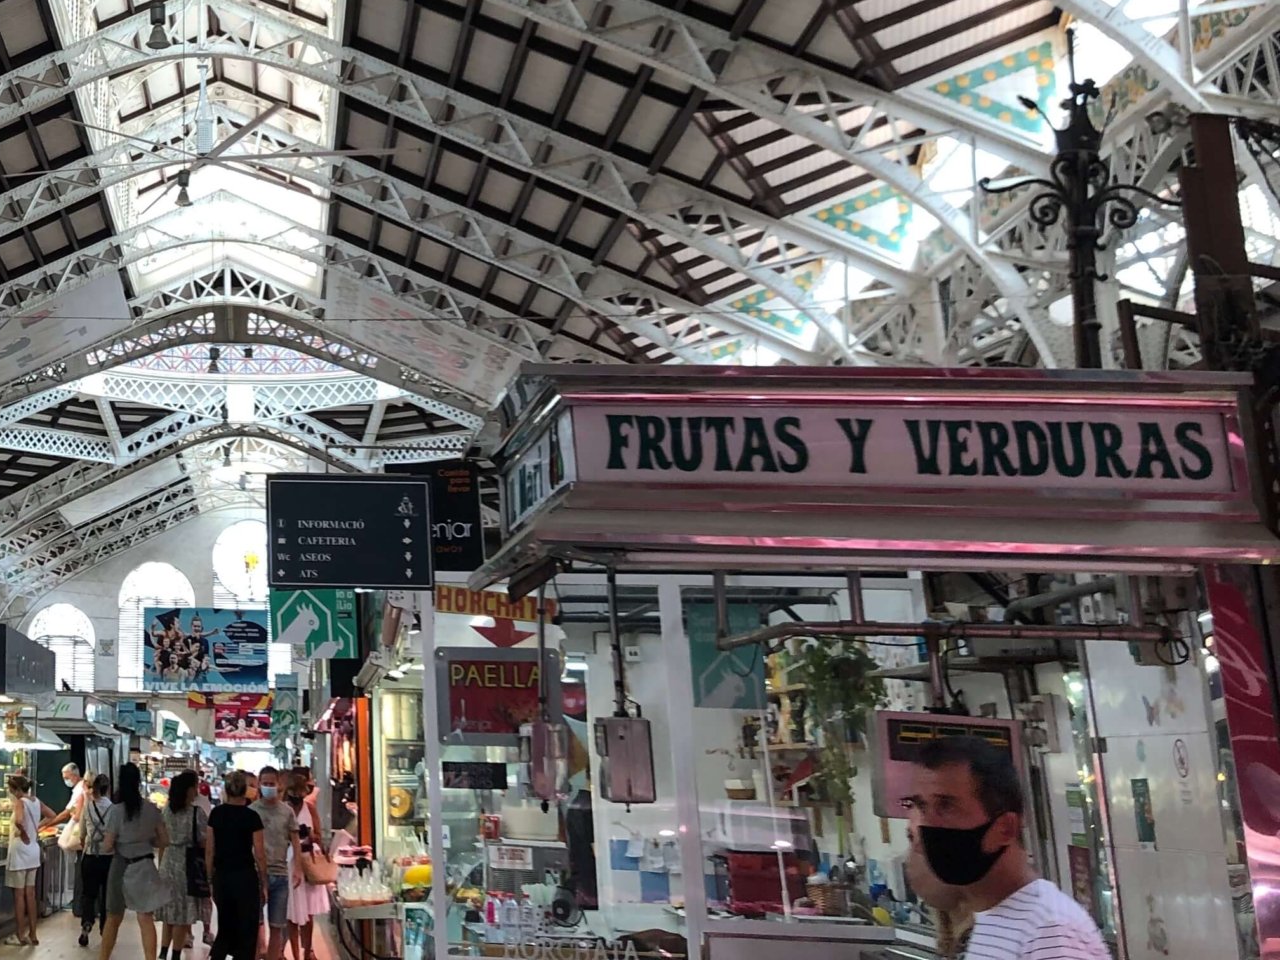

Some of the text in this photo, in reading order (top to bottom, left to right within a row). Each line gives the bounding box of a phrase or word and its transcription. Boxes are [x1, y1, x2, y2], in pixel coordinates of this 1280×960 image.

[604, 414, 1214, 481] FRUTAS Y VERDURAS
[298, 519, 365, 529] INFORMACIÓ
[298, 536, 356, 546] CAFETERIA
[299, 553, 332, 562] ASEOS
[299, 570, 318, 578] ATS
[436, 584, 557, 620] HORCHATA
[451, 664, 540, 688] PAELLA
[144, 681, 269, 693] VIVE LA EMOCIÓN
[503, 939, 640, 960] HORCHATA
